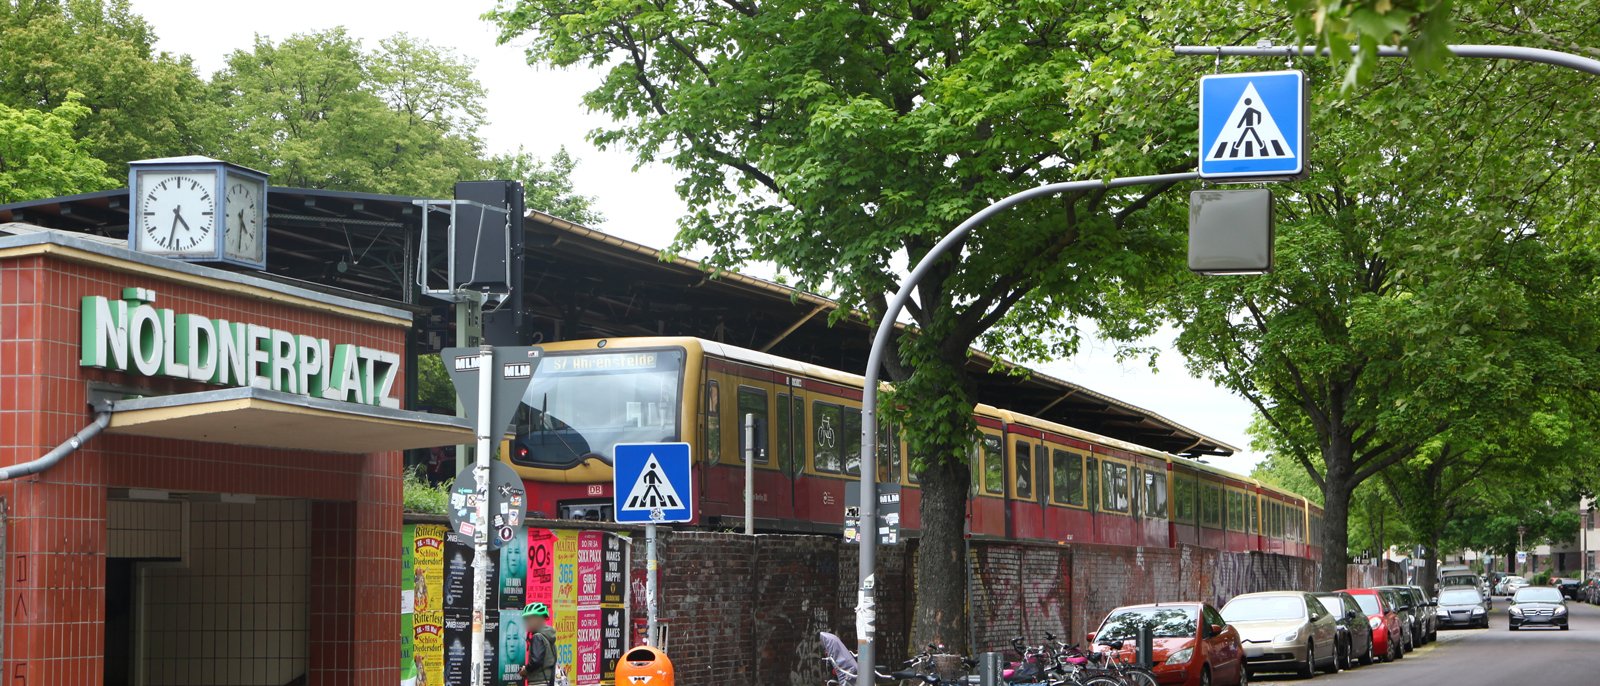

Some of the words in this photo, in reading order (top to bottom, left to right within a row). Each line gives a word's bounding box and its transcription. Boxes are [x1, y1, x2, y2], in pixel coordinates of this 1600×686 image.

[83, 287, 400, 409] NÖLDNERPLATZ
[553, 357, 568, 370] S7
[504, 364, 531, 377] MLM
[588, 485, 602, 495] DB
[880, 494, 899, 503] MLM
[528, 544, 550, 569] 90s
[606, 551, 621, 561] MAKES
[608, 562, 618, 571] YOU
[559, 563, 573, 583] 365
[605, 572, 621, 582] HAPPY!
[583, 574, 597, 584] GIRLS
[583, 584, 597, 594] ONLY
[414, 611, 443, 624] Ritterfest
[605, 628, 620, 638] MAKES
[608, 639, 617, 648] YOU
[558, 644, 572, 664] 365
[583, 653, 597, 663] GIRLS
[604, 649, 620, 659] HAPPY!
[582, 663, 596, 673] ONLY
